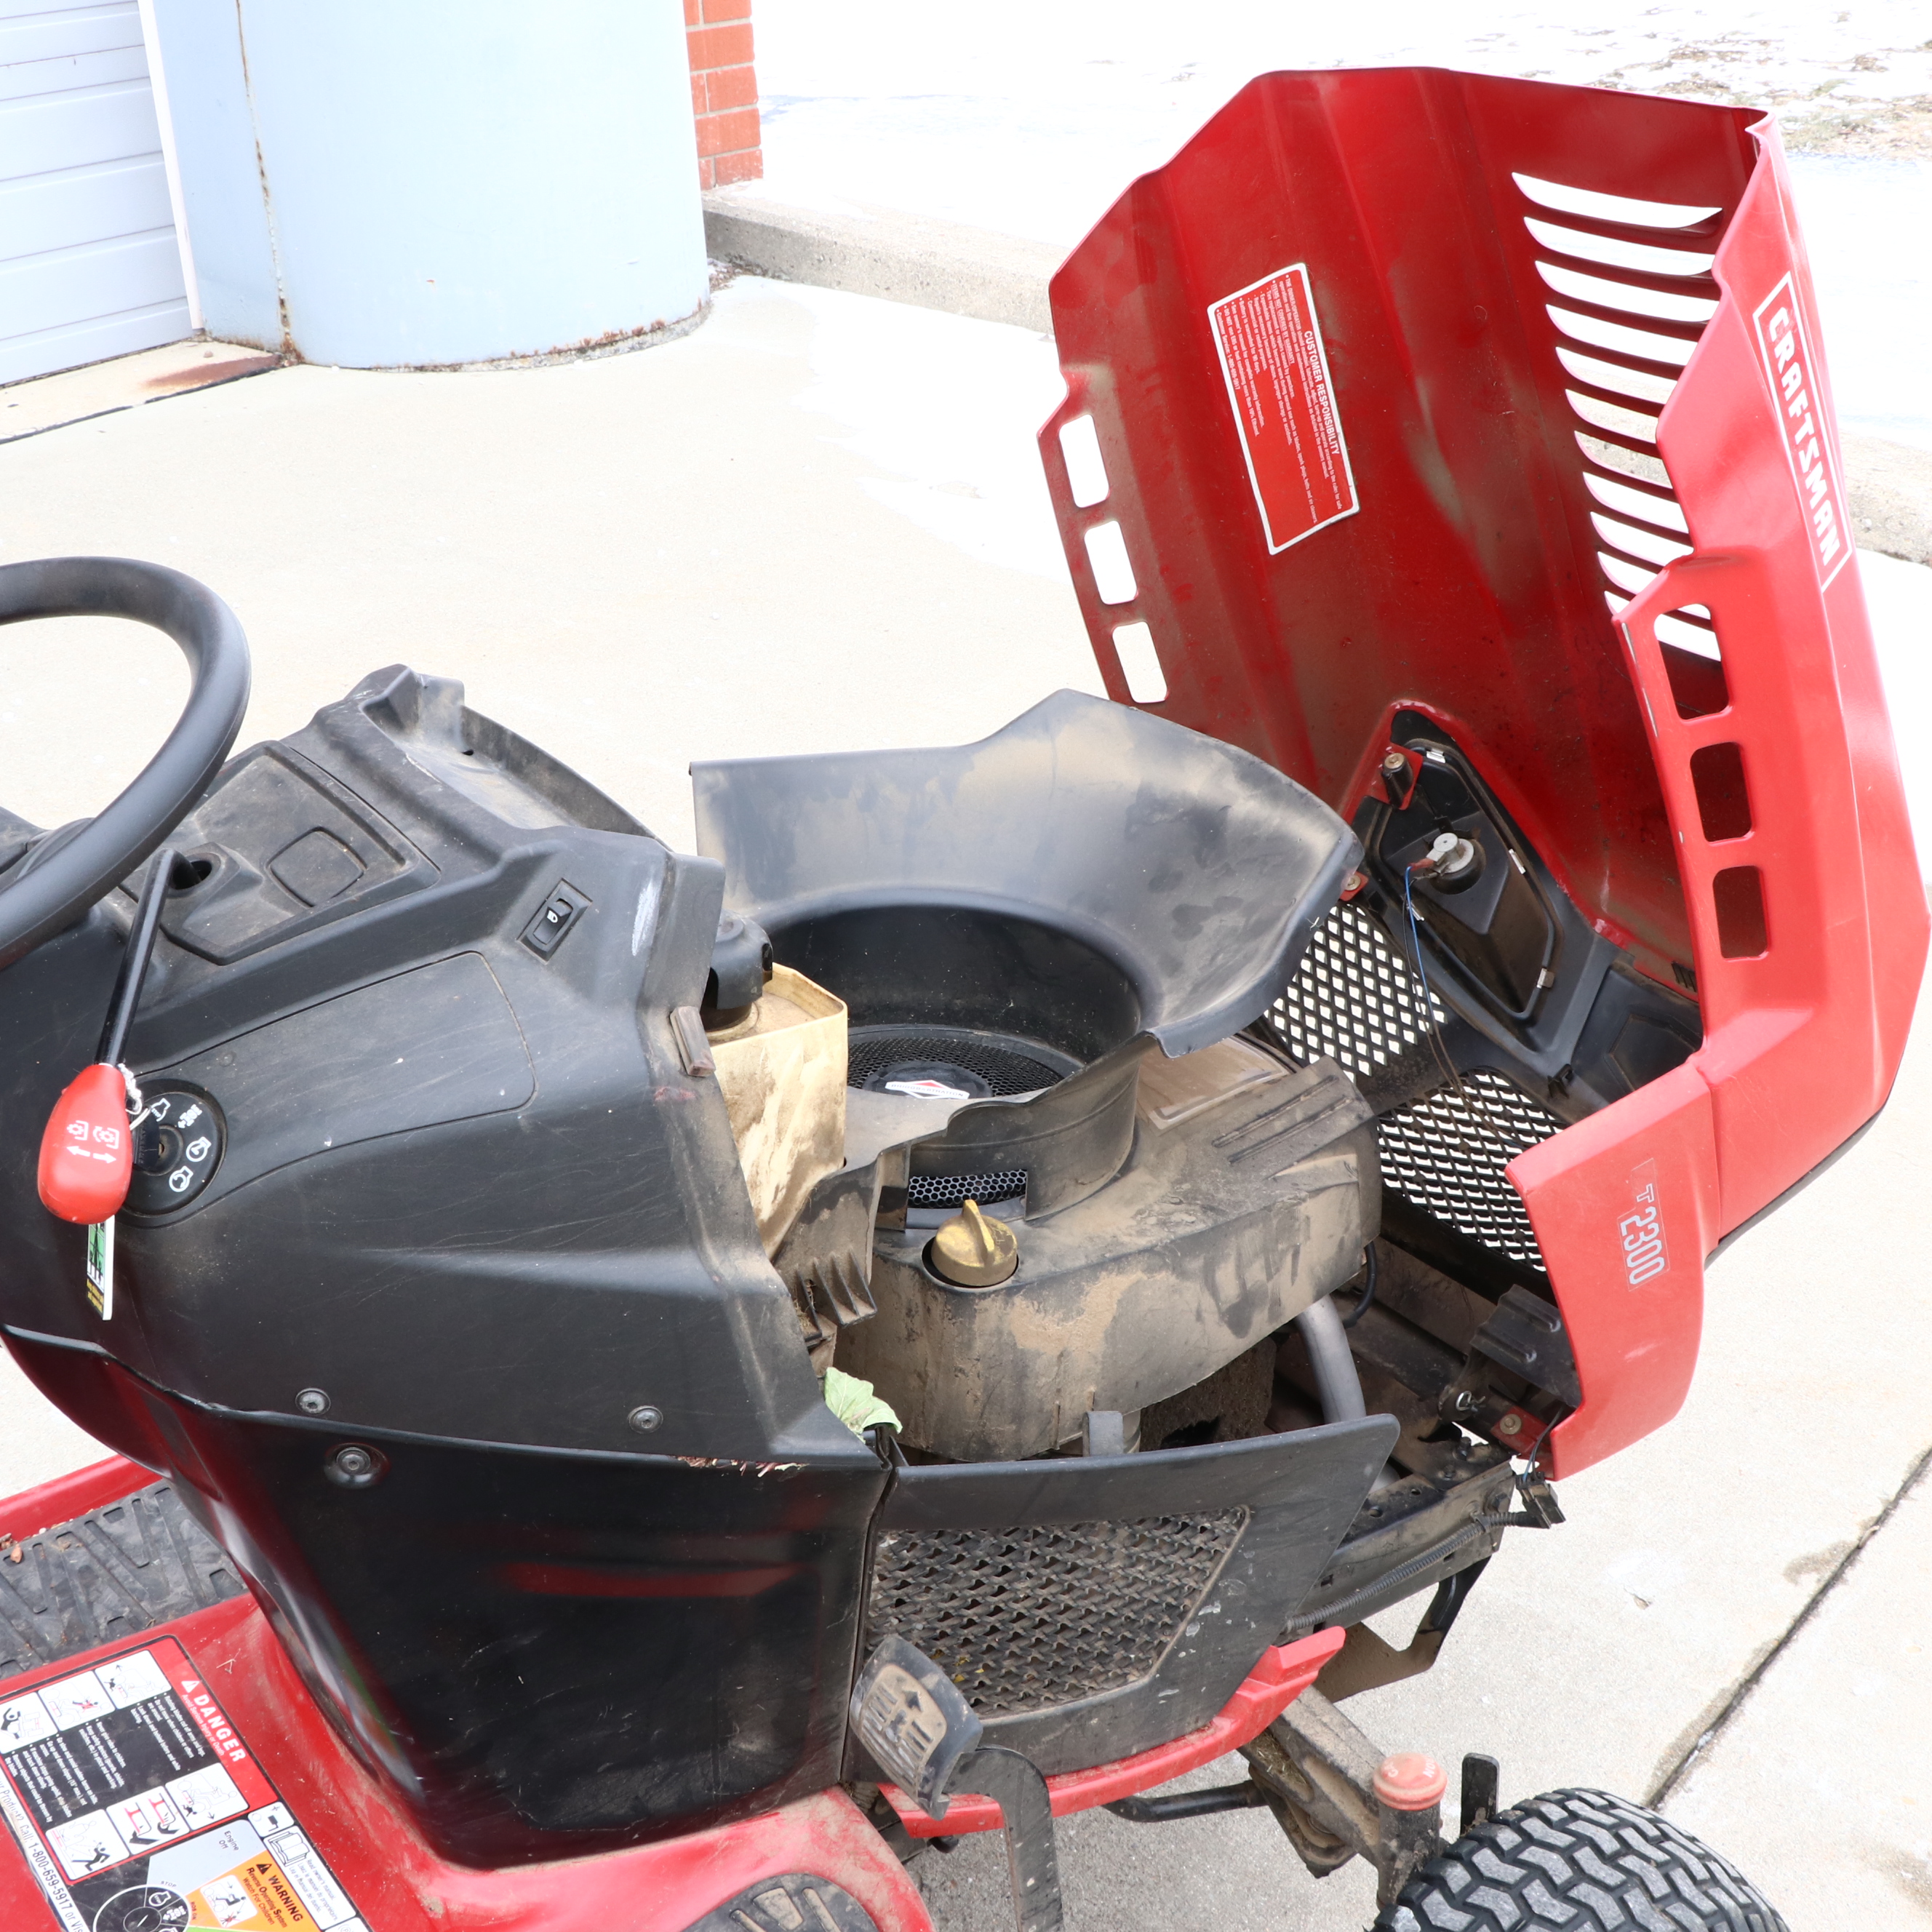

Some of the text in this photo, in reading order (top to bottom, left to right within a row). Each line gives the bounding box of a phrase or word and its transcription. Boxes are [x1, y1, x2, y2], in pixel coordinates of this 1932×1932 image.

[1271, 283, 1280, 299] ITEMS
[1277, 308, 1287, 331] COVERED
[1282, 330, 1288, 338] BY
[1283, 338, 1295, 364] WARRANTY
[1304, 330, 1339, 453] CUSTOMER RESPONSIBILITY
[1768, 306, 1840, 566] CRAFTSMAN
[181, 1694, 194, 1707] Avoid
[190, 1706, 204, 1724] Serious
[201, 1723, 212, 1736] Injury
[212, 1741, 224, 1755] Death
[193, 1693, 245, 1761] DANGER
[218, 1840, 228, 1848] Off
[224, 1830, 239, 1850] Engine
[28, 1843, 73, 1909] 1-800-659-5917
[65, 1911, 76, 1920] or
[243, 1877, 274, 1925] Watch For Children
[246, 1867, 287, 1927] Reverse Operating System
[268, 1875, 303, 1921] WARNING
